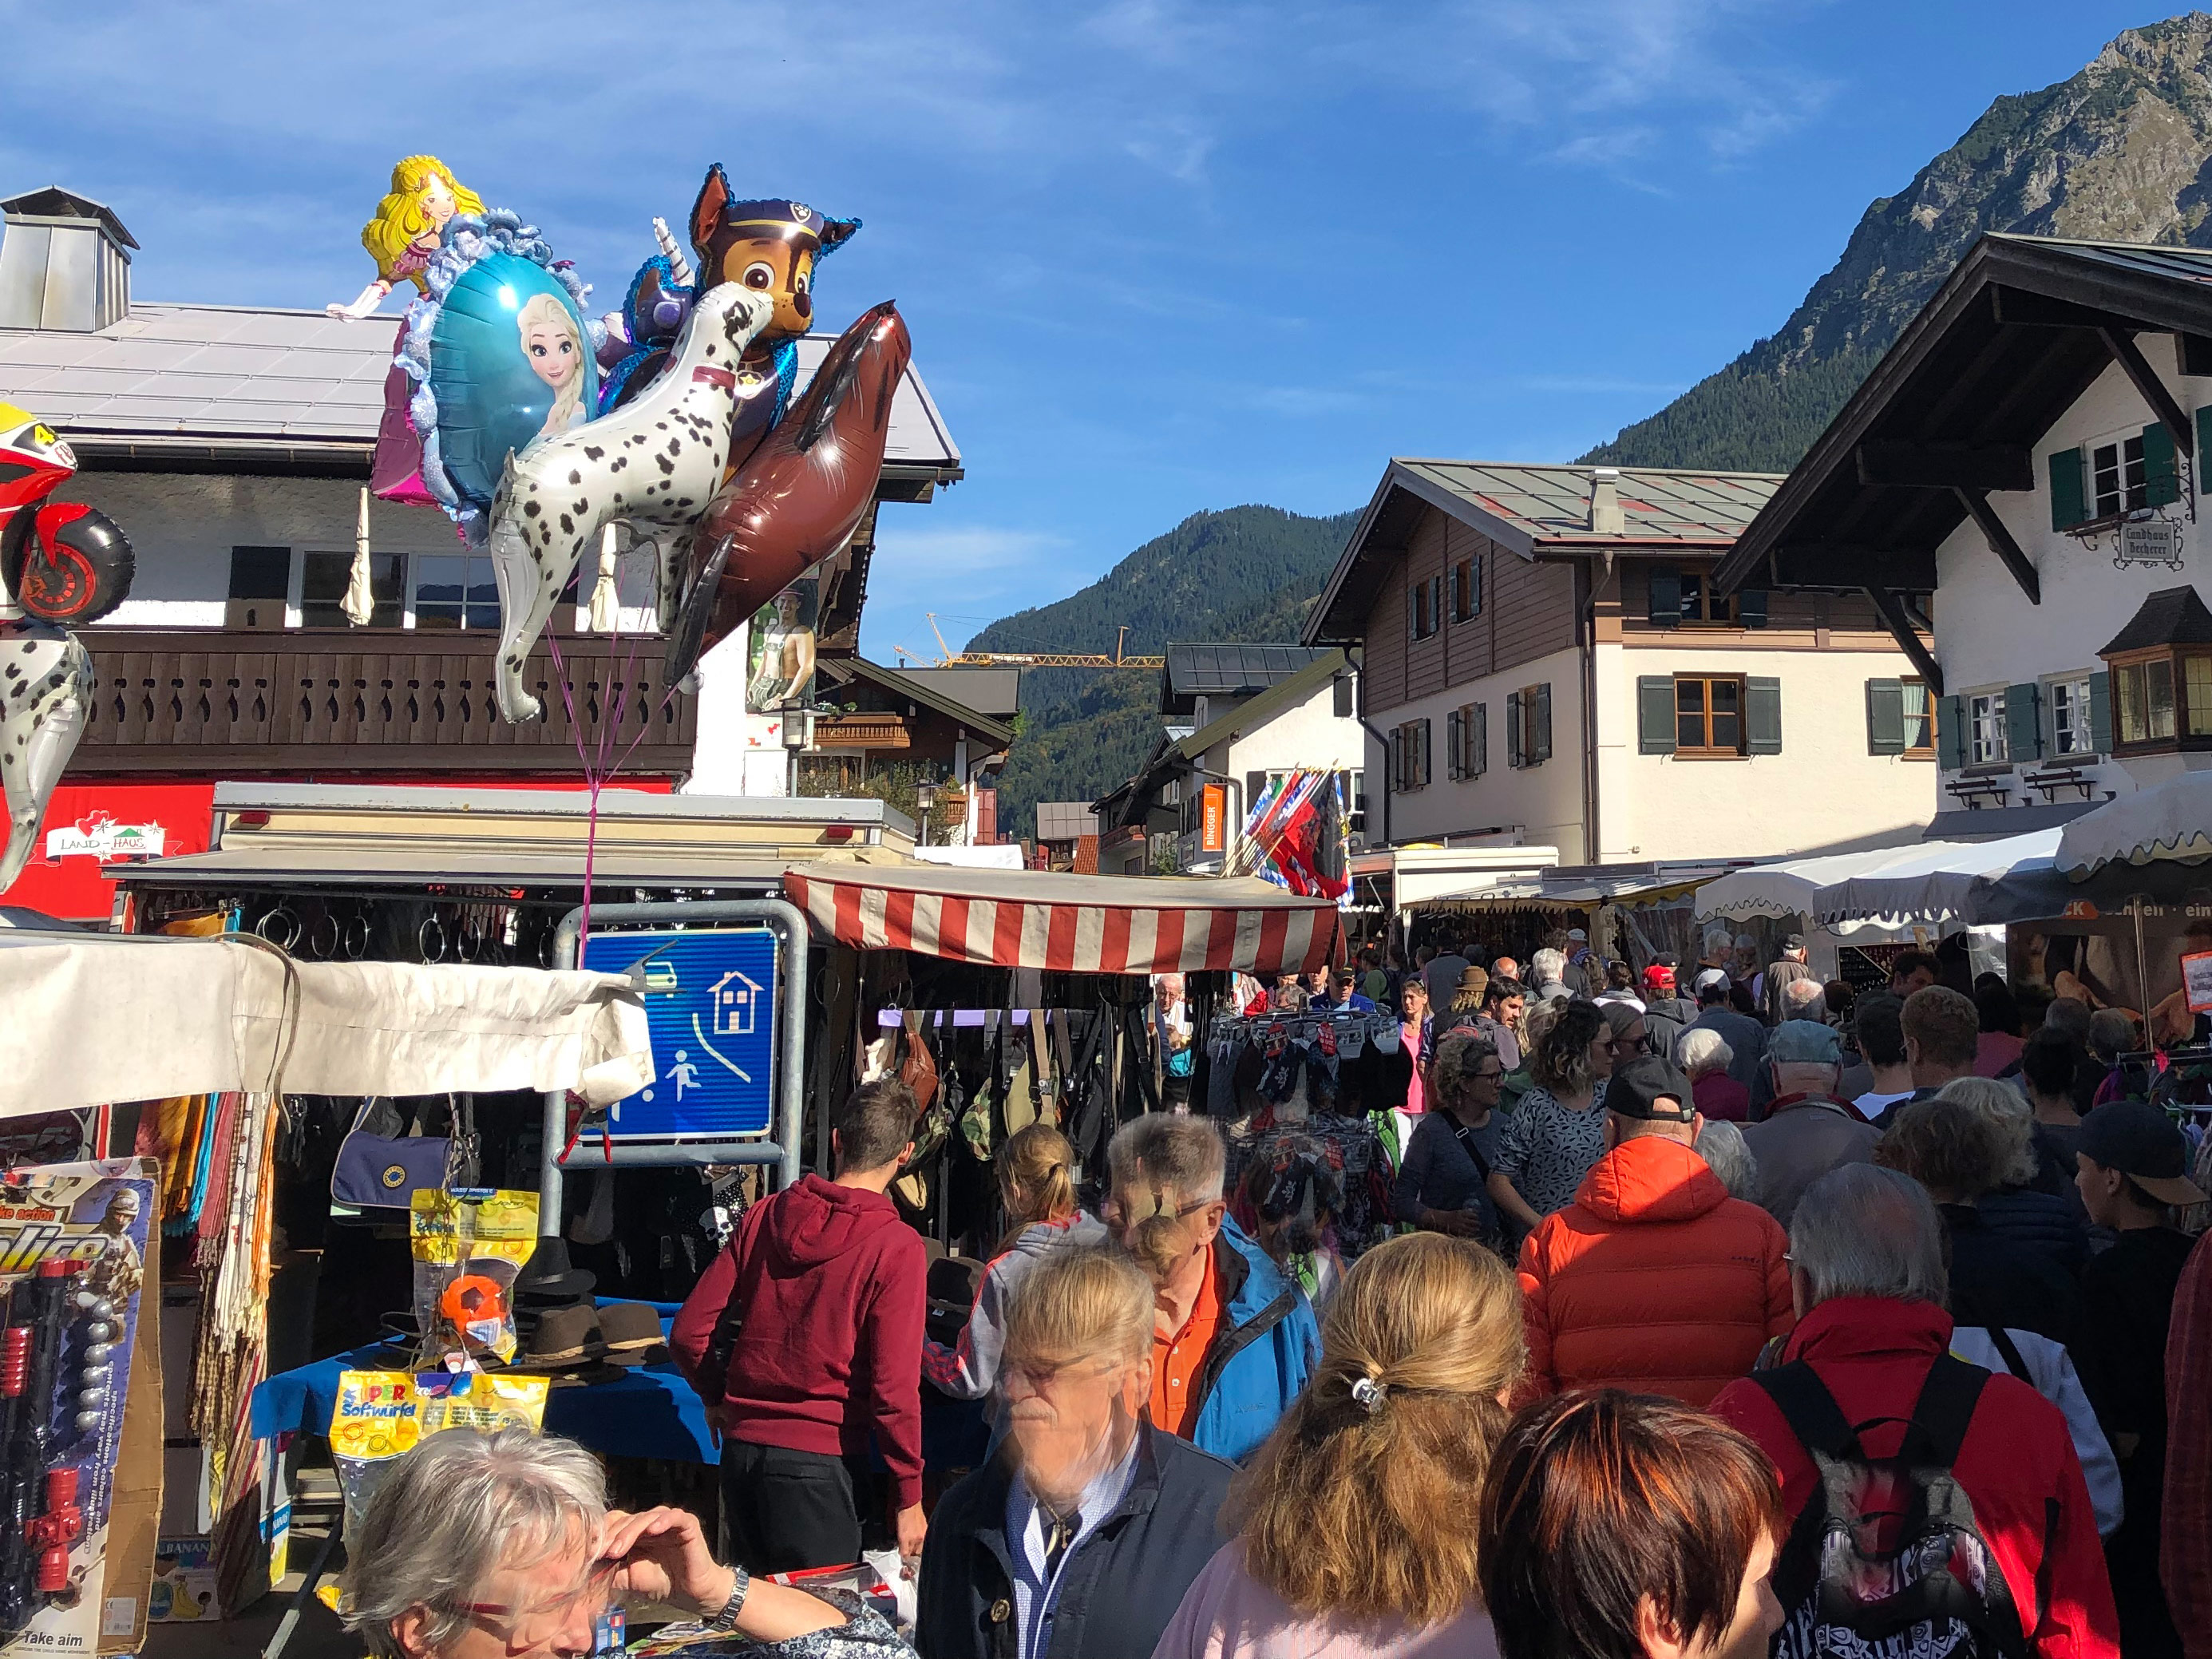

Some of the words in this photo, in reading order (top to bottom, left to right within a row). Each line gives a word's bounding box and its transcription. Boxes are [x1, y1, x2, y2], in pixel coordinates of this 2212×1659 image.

[2126, 528, 2169, 540] Landhaus
[2129, 542, 2167, 555] Becherer
[61, 839, 100, 849] LAND
[113, 838, 144, 849] HAUS
[15, 1206, 56, 1221] action
[0, 1224, 109, 1275] lice
[104, 1360, 113, 1408] contents
[98, 1410, 107, 1433] may
[95, 1435, 104, 1459] vary
[93, 1462, 101, 1487] from
[24, 1629, 54, 1645] Take
[57, 1633, 83, 1647] aim
